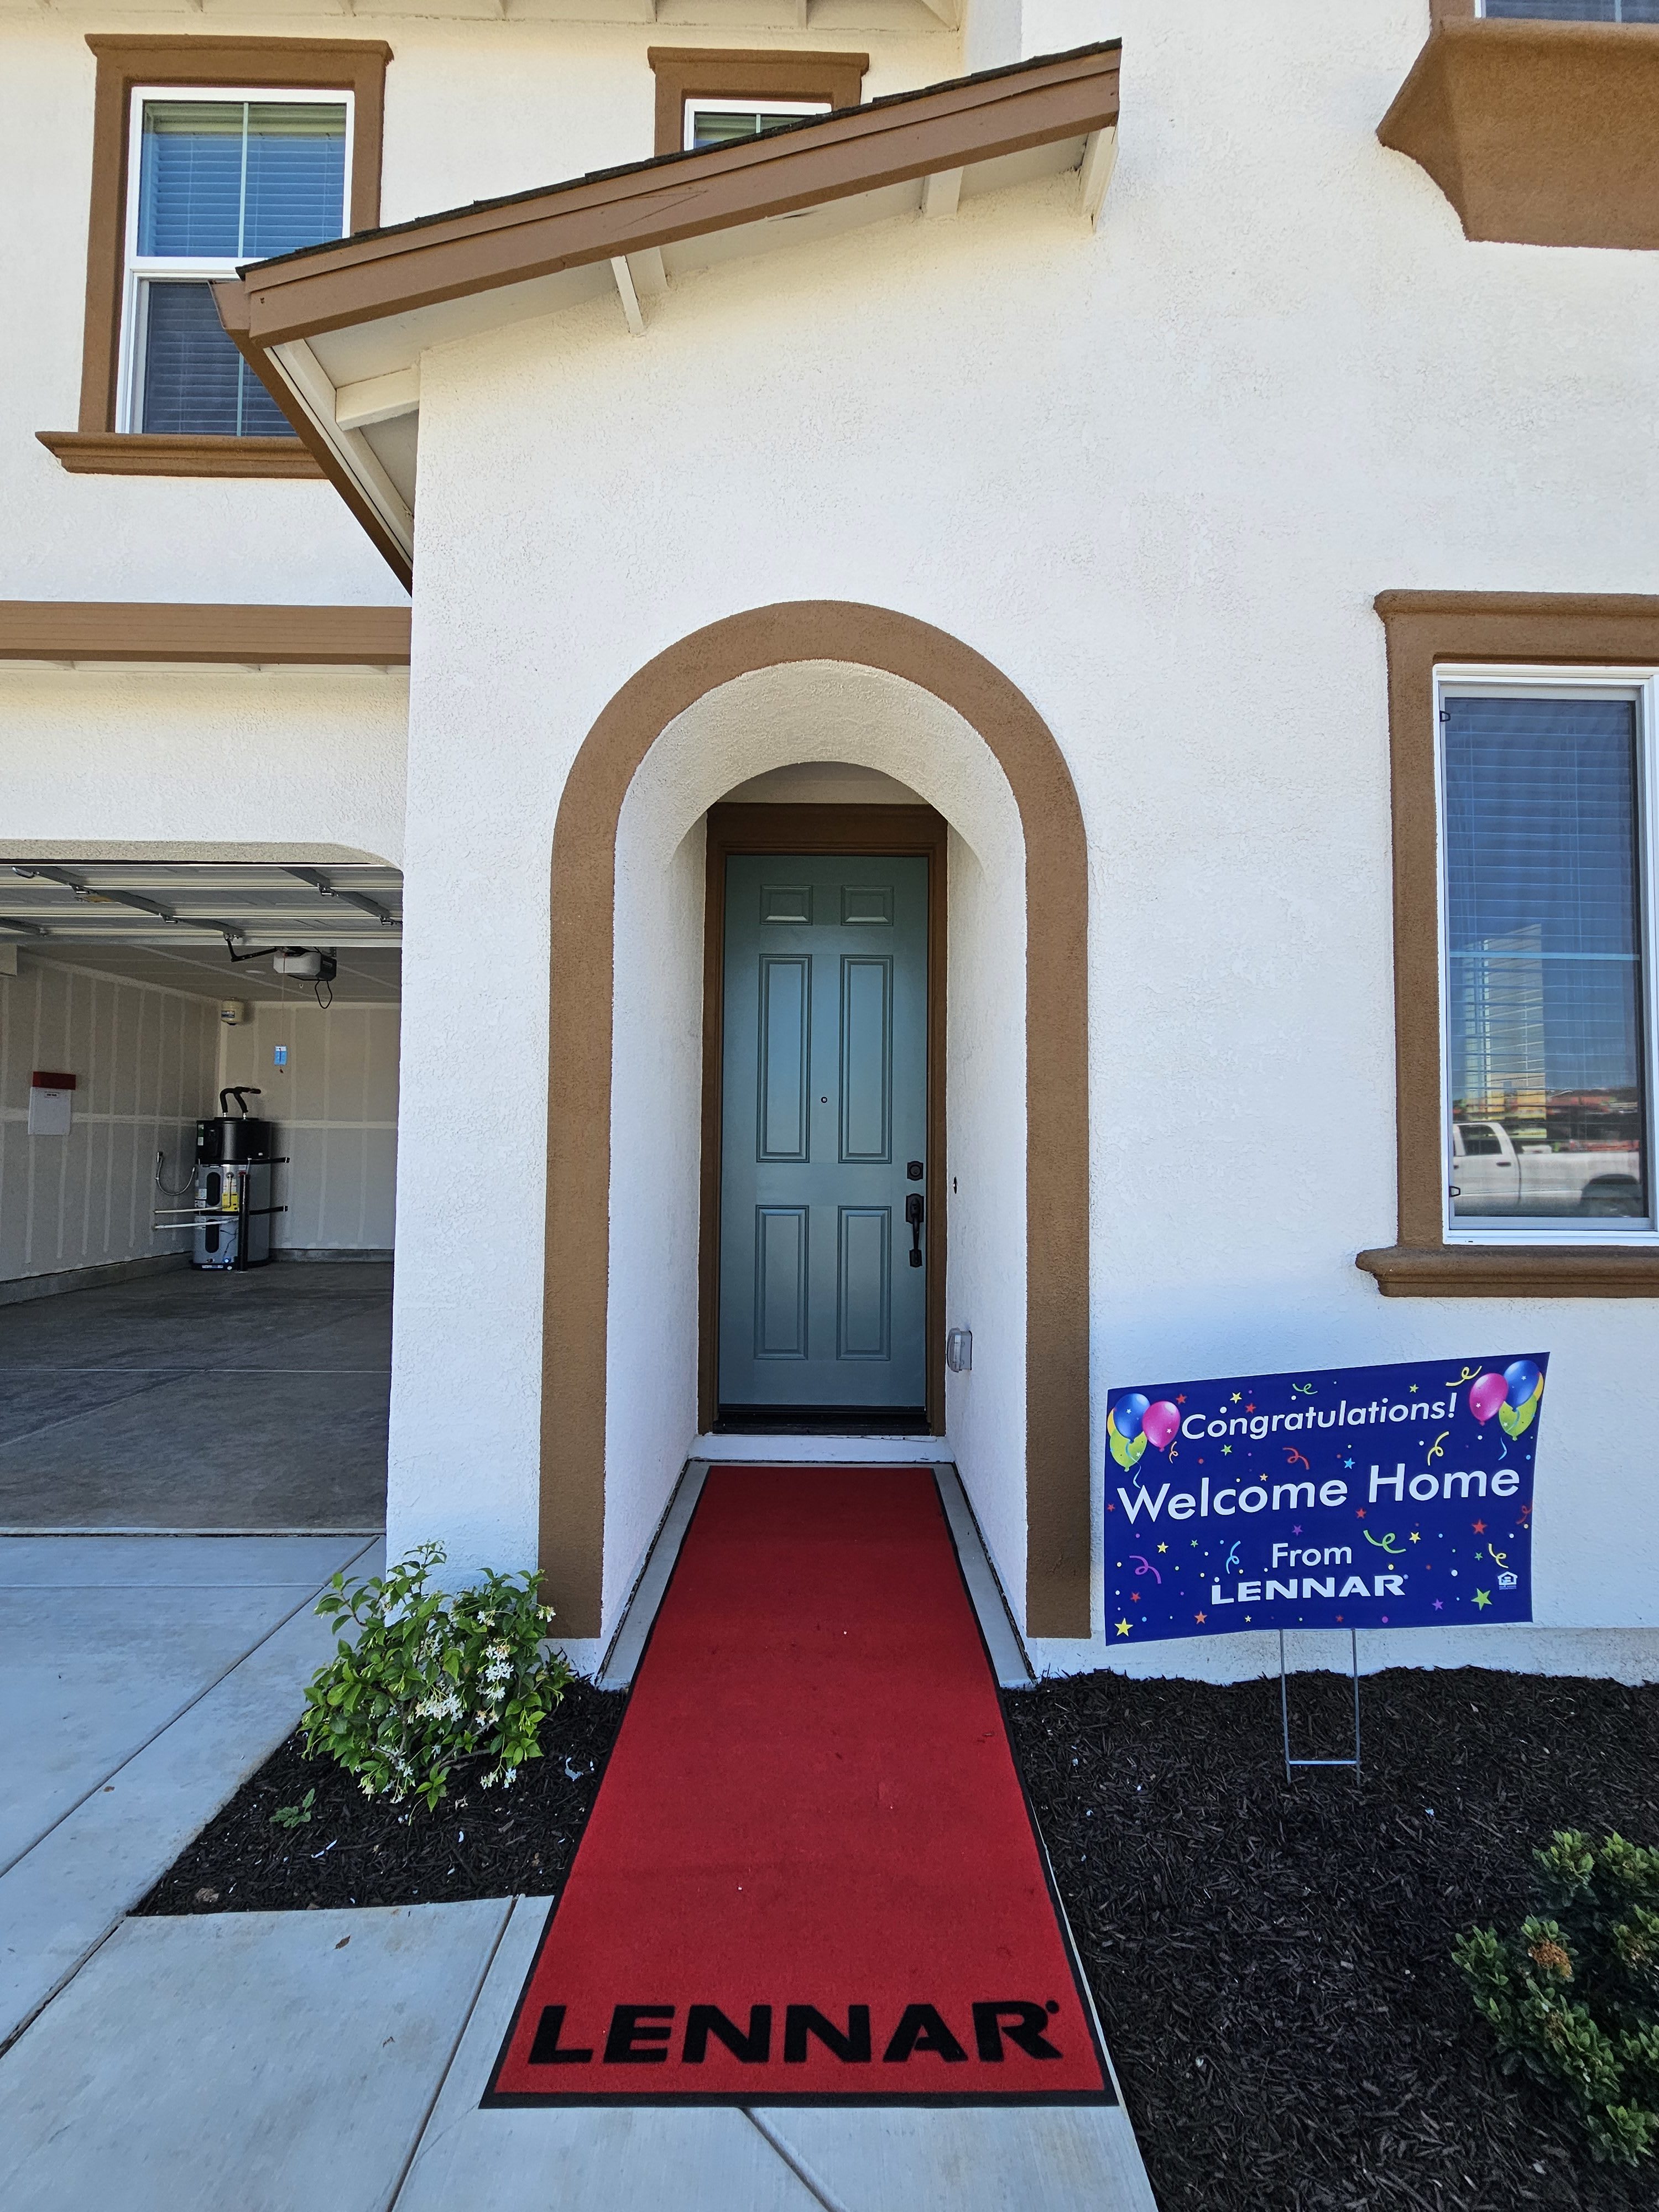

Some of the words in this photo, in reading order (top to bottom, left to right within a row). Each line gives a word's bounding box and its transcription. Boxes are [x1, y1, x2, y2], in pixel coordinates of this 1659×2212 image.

[1181, 1392, 1457, 1439] Congratulations!
[1117, 1477, 1348, 1525] Welcome
[1369, 1463, 1520, 1503] Home
[1272, 1542, 1352, 1568] From
[1212, 1574, 1406, 1605] LENNAR
[527, 2000, 1063, 2064] LENNAR
